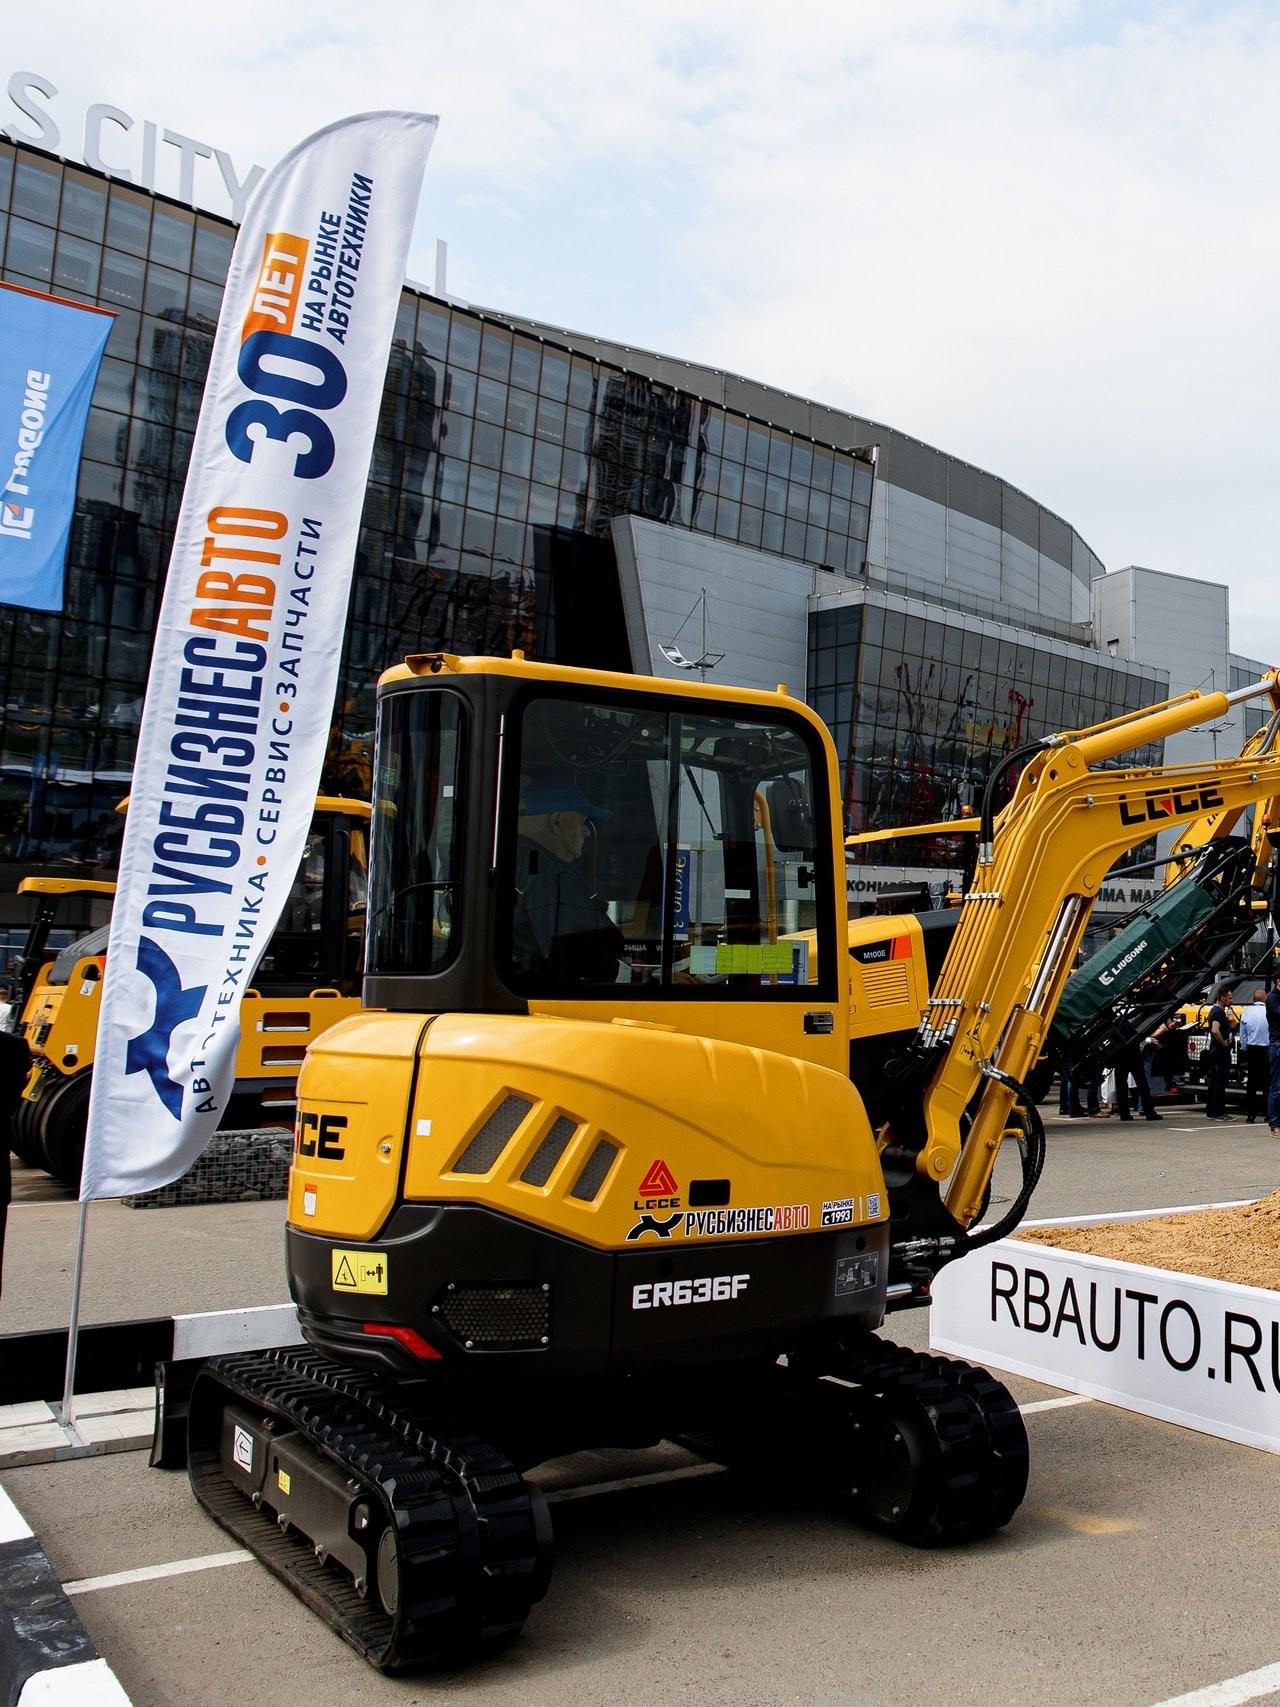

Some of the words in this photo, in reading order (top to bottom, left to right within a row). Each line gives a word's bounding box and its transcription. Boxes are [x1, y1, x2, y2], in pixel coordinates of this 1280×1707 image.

[83, 103, 266, 222] CITY
[308, 211, 342, 297] РЫНКЕ
[325, 172, 374, 346] АВТОТЕХНИКИ
[252, 244, 299, 325] ЛЕТ
[300, 301, 327, 333] НА
[225, 330, 348, 480] 30
[256, 718, 293, 845] СЕРВИС
[276, 517, 323, 698] ЗАПЧАСТИ
[142, 506, 289, 937] РУСБИЗНЕСАВТО
[1118, 777, 1225, 827] LGCE
[863, 949, 887, 959] M100E
[634, 1198, 680, 1210] LGCE
[685, 1204, 809, 1236] РУСБИЗНЕСАВТО
[831, 1210, 850, 1222] 1993
[833, 1200, 853, 1209] РЫНКЕ
[632, 1274, 750, 1310] ER636F
